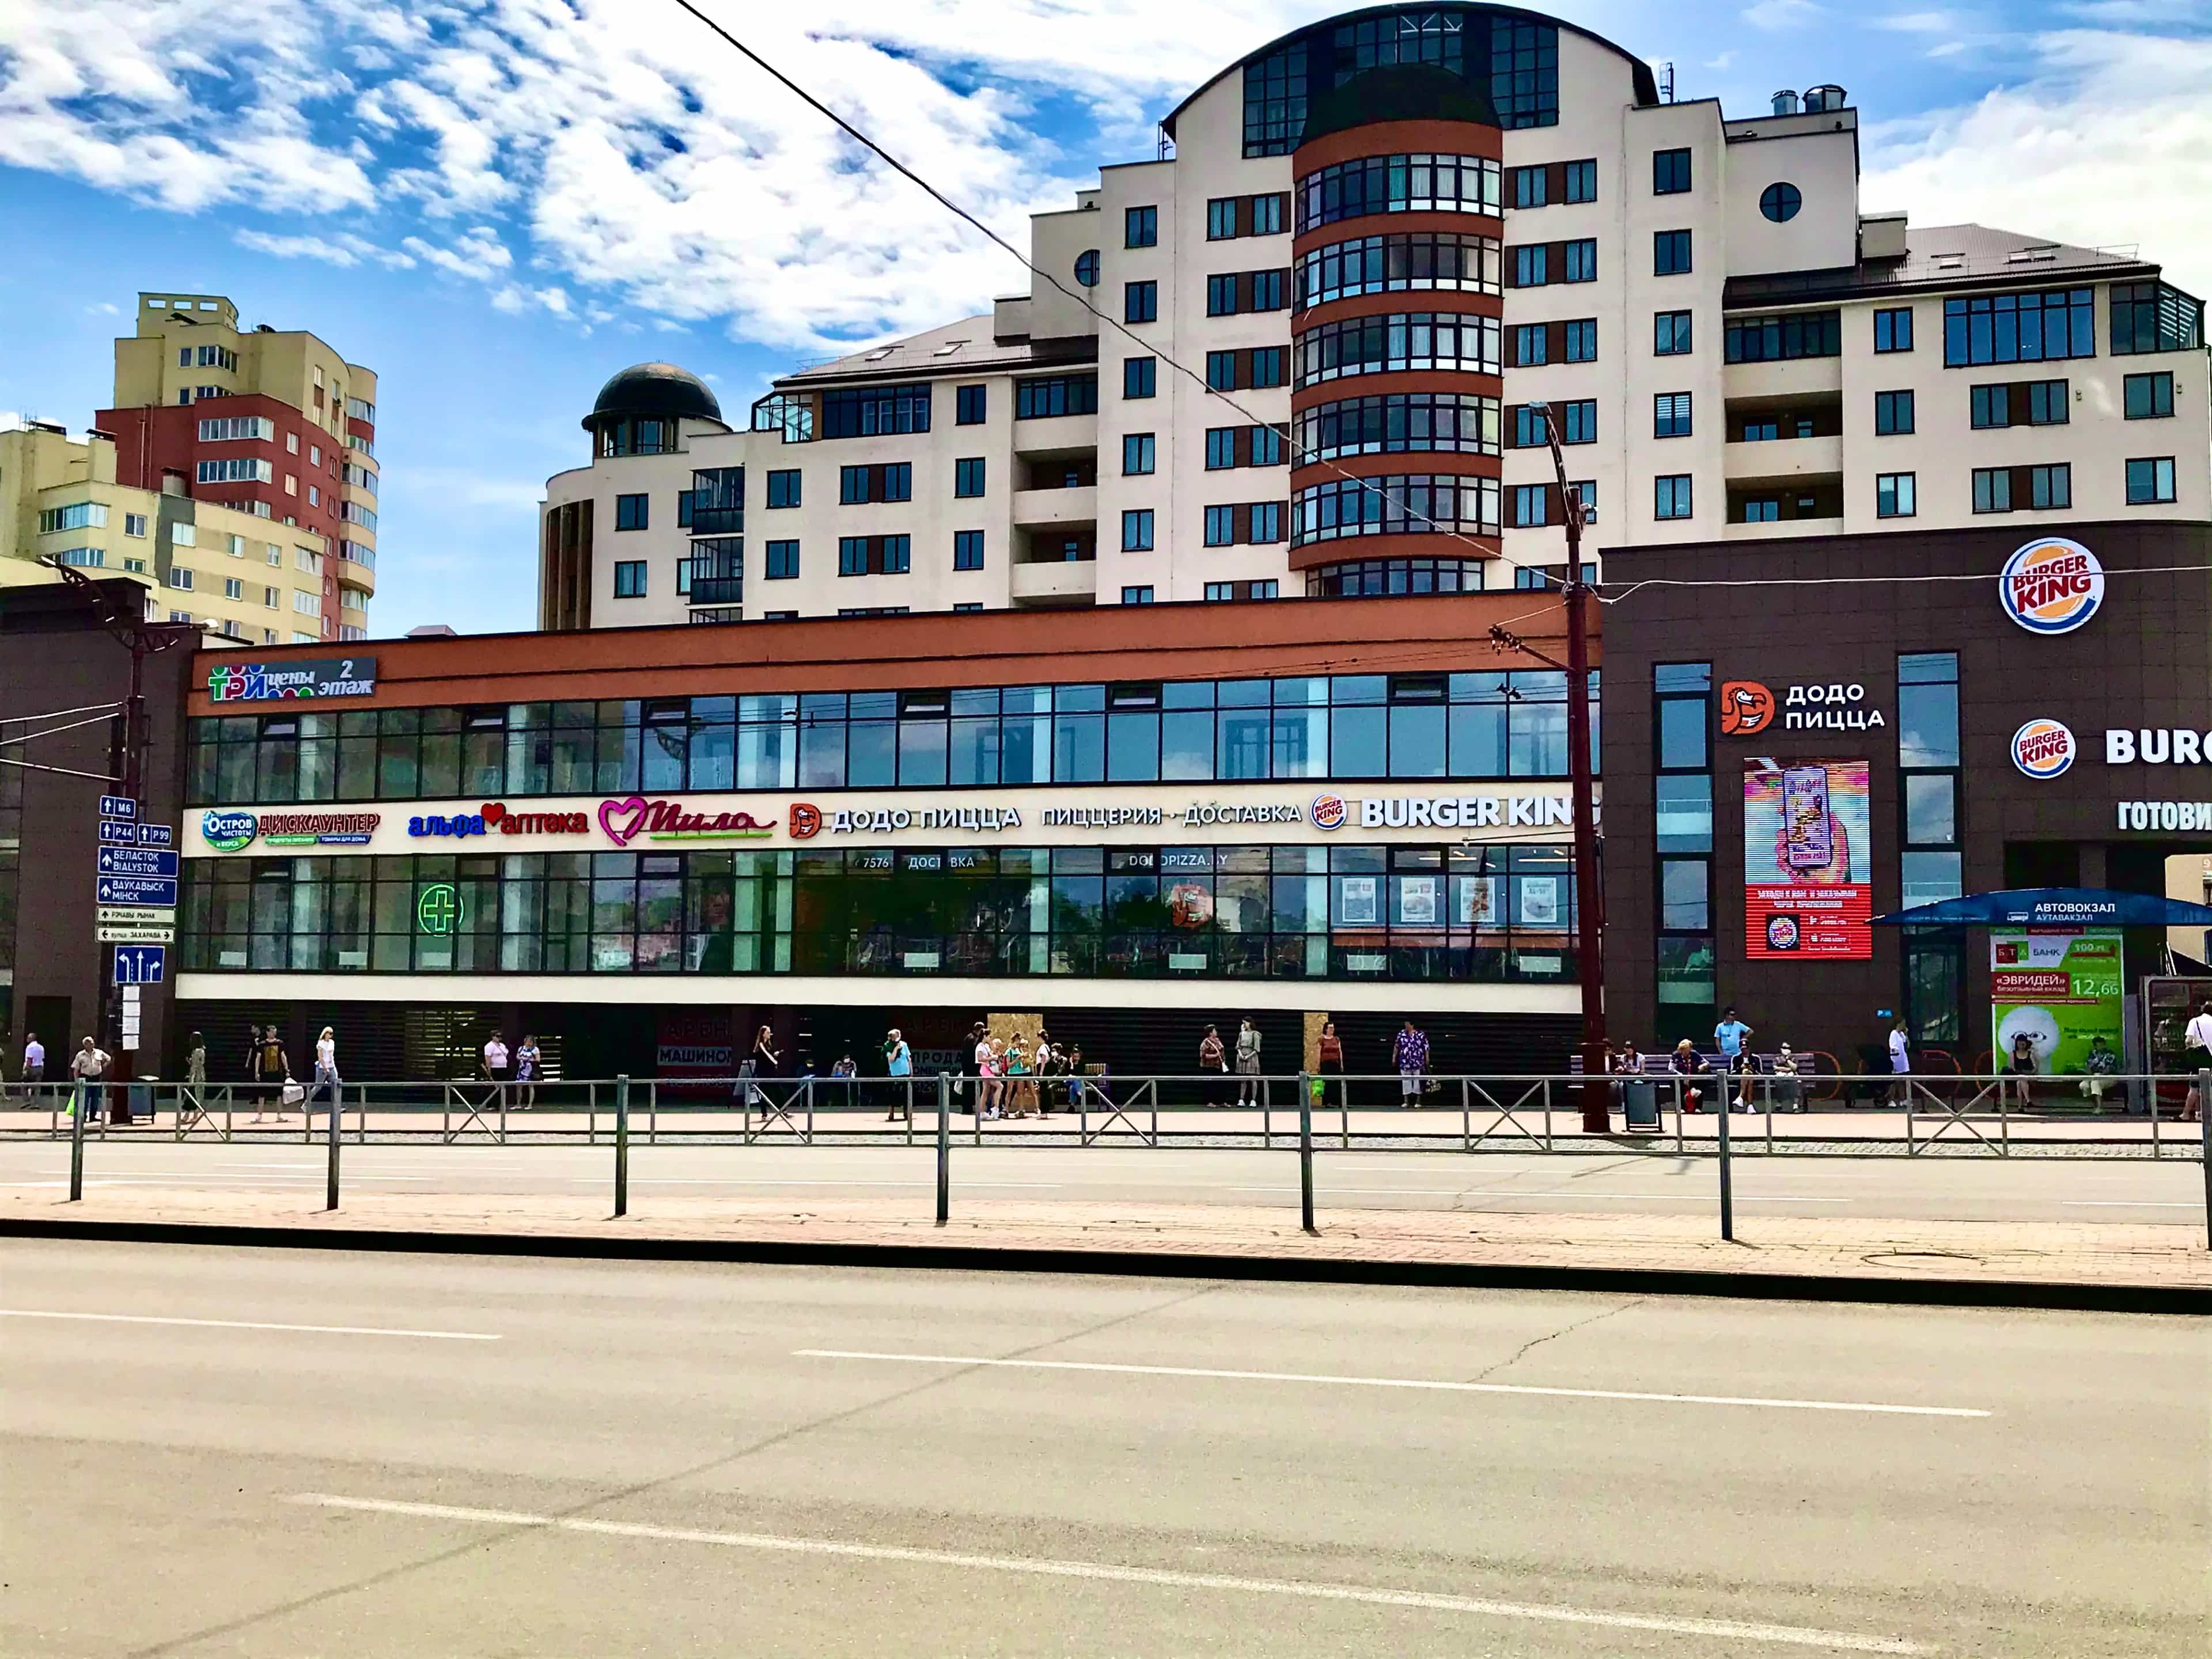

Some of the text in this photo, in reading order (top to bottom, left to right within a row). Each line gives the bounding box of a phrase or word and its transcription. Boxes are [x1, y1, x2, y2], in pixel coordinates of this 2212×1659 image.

[2013, 555, 2088, 592] BURGER
[2017, 570, 2091, 614] KING
[340, 660, 354, 679] 2
[267, 671, 316, 688] цены
[317, 679, 374, 696] этаж
[1786, 684, 1865, 706] ДОДО
[1786, 710, 1885, 730] ПИЦЦА
[2019, 730, 2066, 751] BURGER
[2022, 745, 2068, 767] KING
[1040, 804, 1303, 828] ПИЦЦЕРИЯ ДОСТАВКА
[1315, 800, 1342, 813] BURGER
[1316, 805, 1343, 821] KING
[1361, 797, 1502, 828] BURGER
[258, 812, 380, 835] ДИСКАУНТЕР
[408, 812, 590, 839] альфа аптека
[831, 808, 1022, 833] ДОДО ПИЦЦА
[113, 850, 159, 862] БЕЛАСТОК
[864, 857, 975, 870] 7576 ДОСТВКА
[112, 861, 159, 874] BIALYSTOK
[2035, 903, 2115, 912] АВТОВОКЗАЛ
[2033, 948, 2061, 956] БАНК
[1997, 974, 2065, 986] «ЭВРИДЕЙ»
[2073, 979, 2119, 997] 12,66
